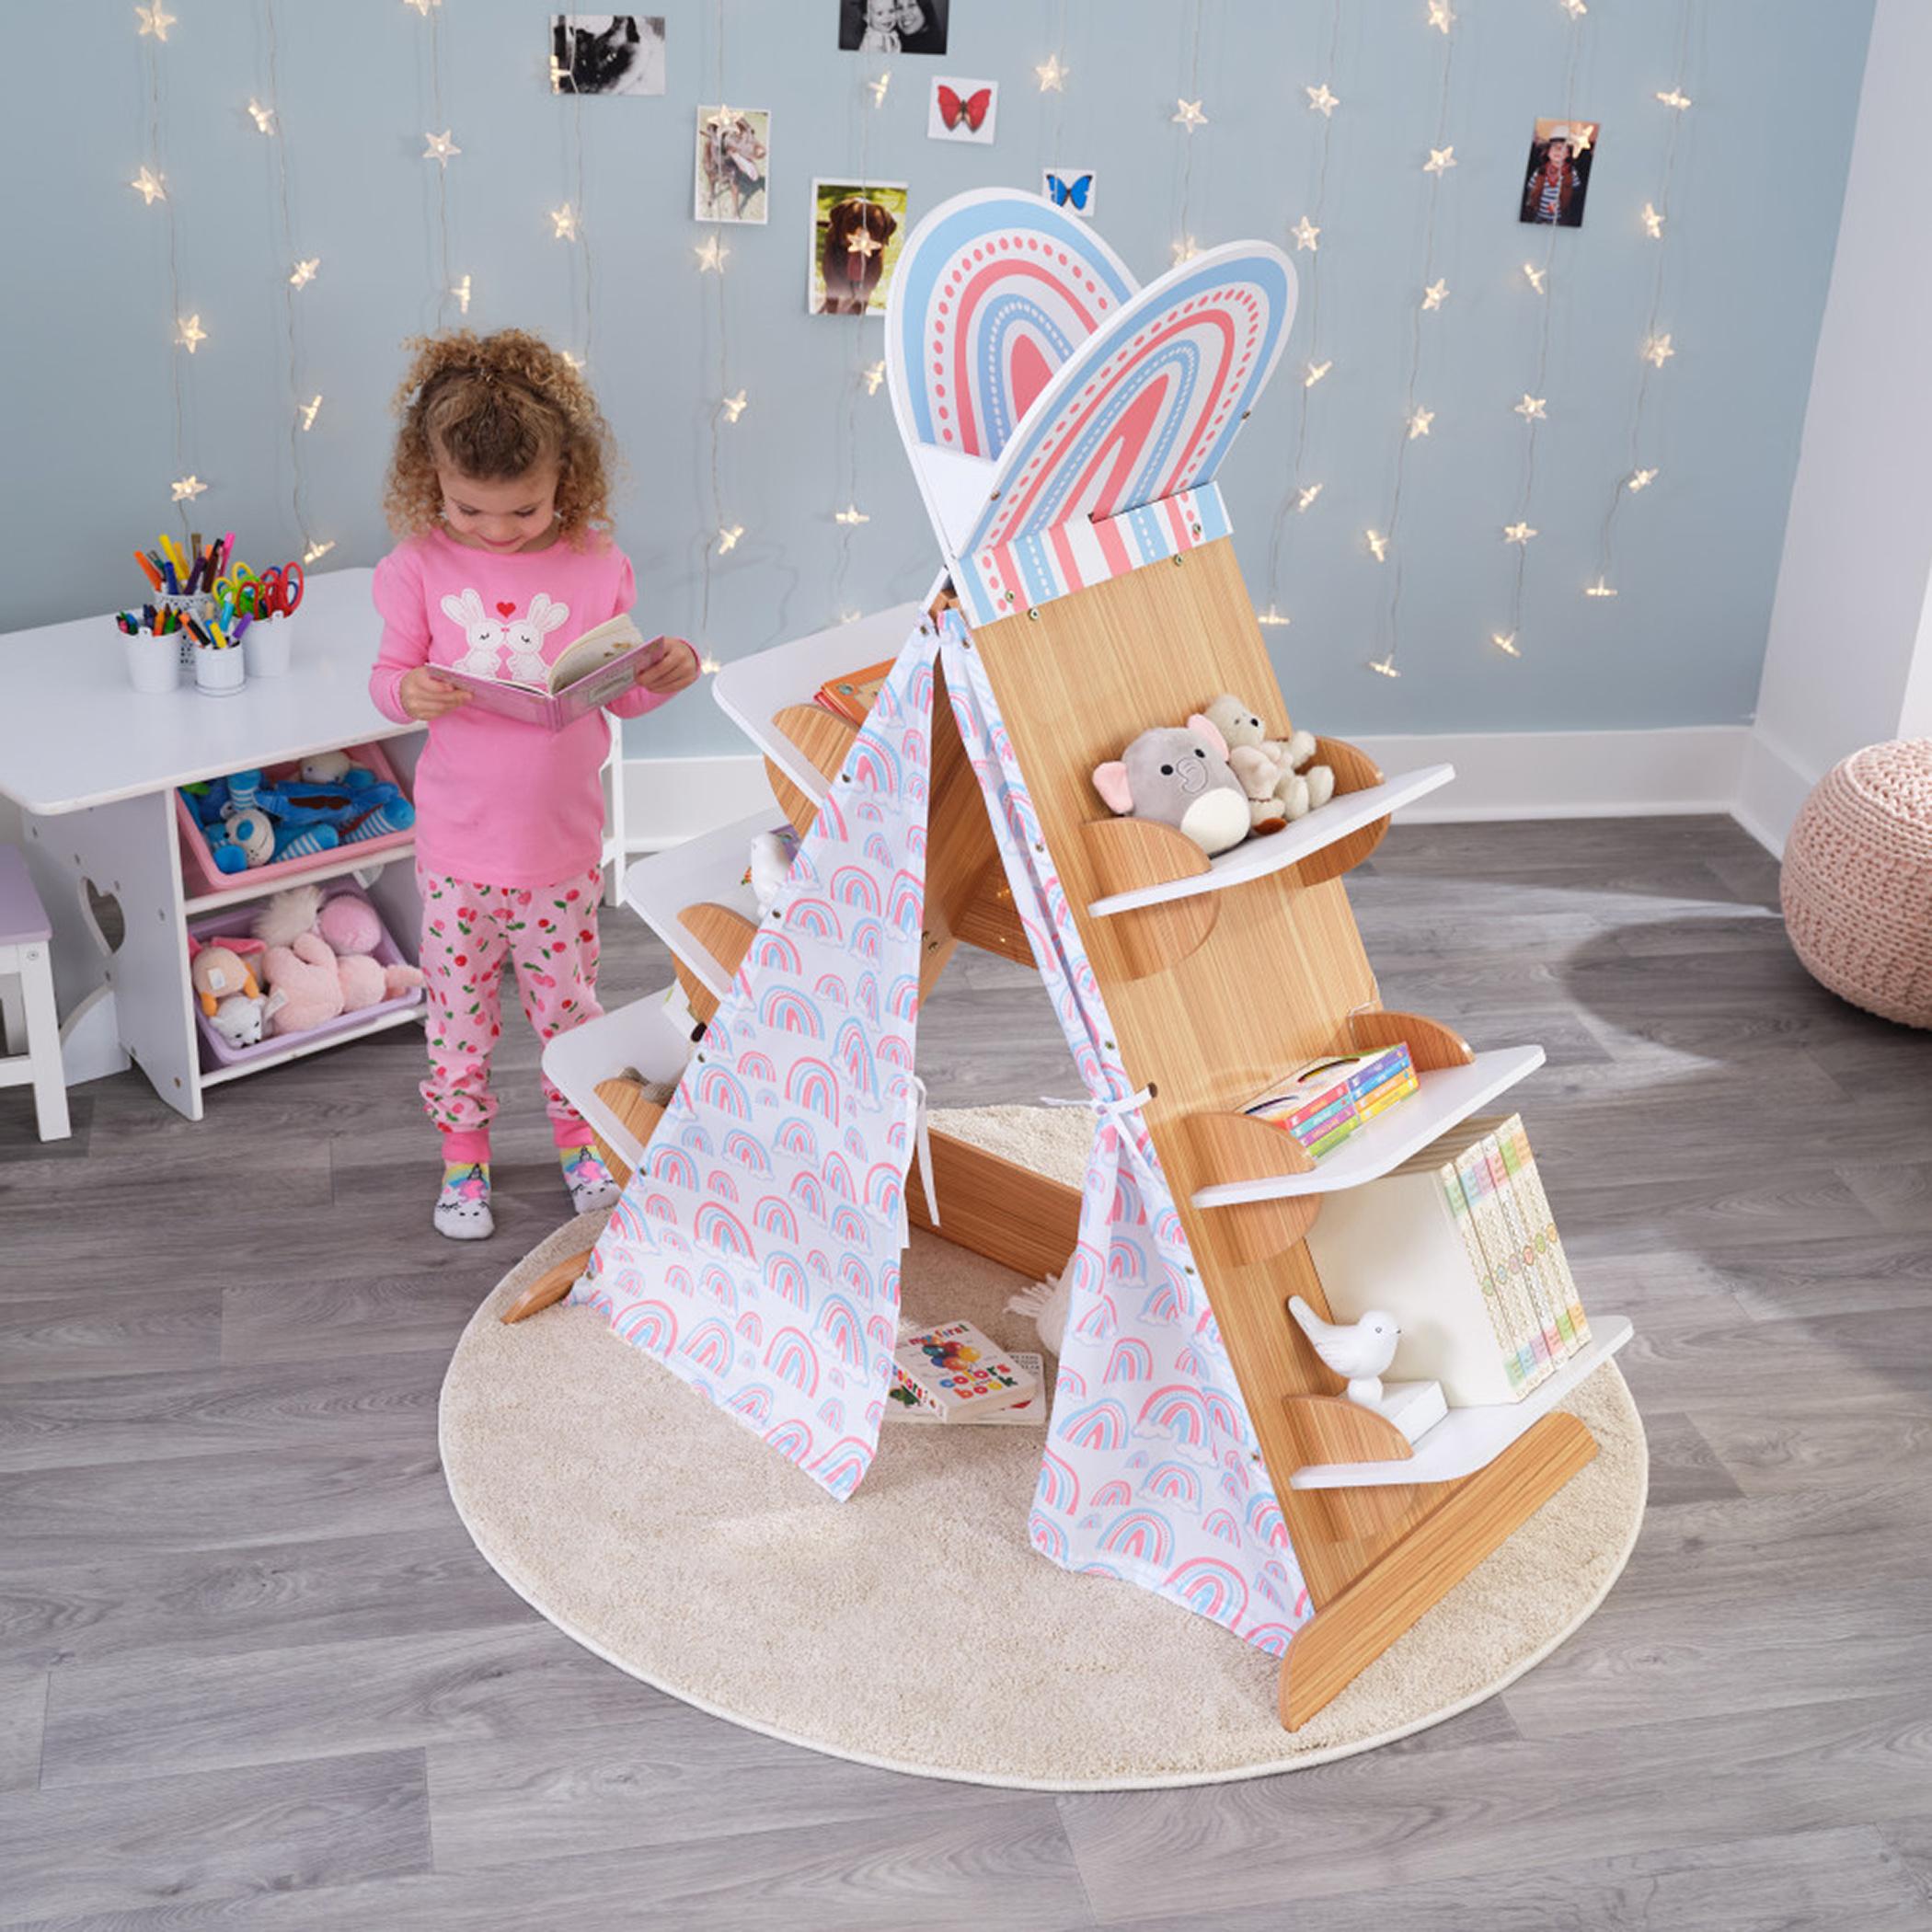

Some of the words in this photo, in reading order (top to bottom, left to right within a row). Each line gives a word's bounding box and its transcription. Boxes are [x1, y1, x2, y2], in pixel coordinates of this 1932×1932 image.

[935, 1324, 970, 1338] first
[939, 1363, 1011, 1388] colors
[952, 1374, 1018, 1398] book
